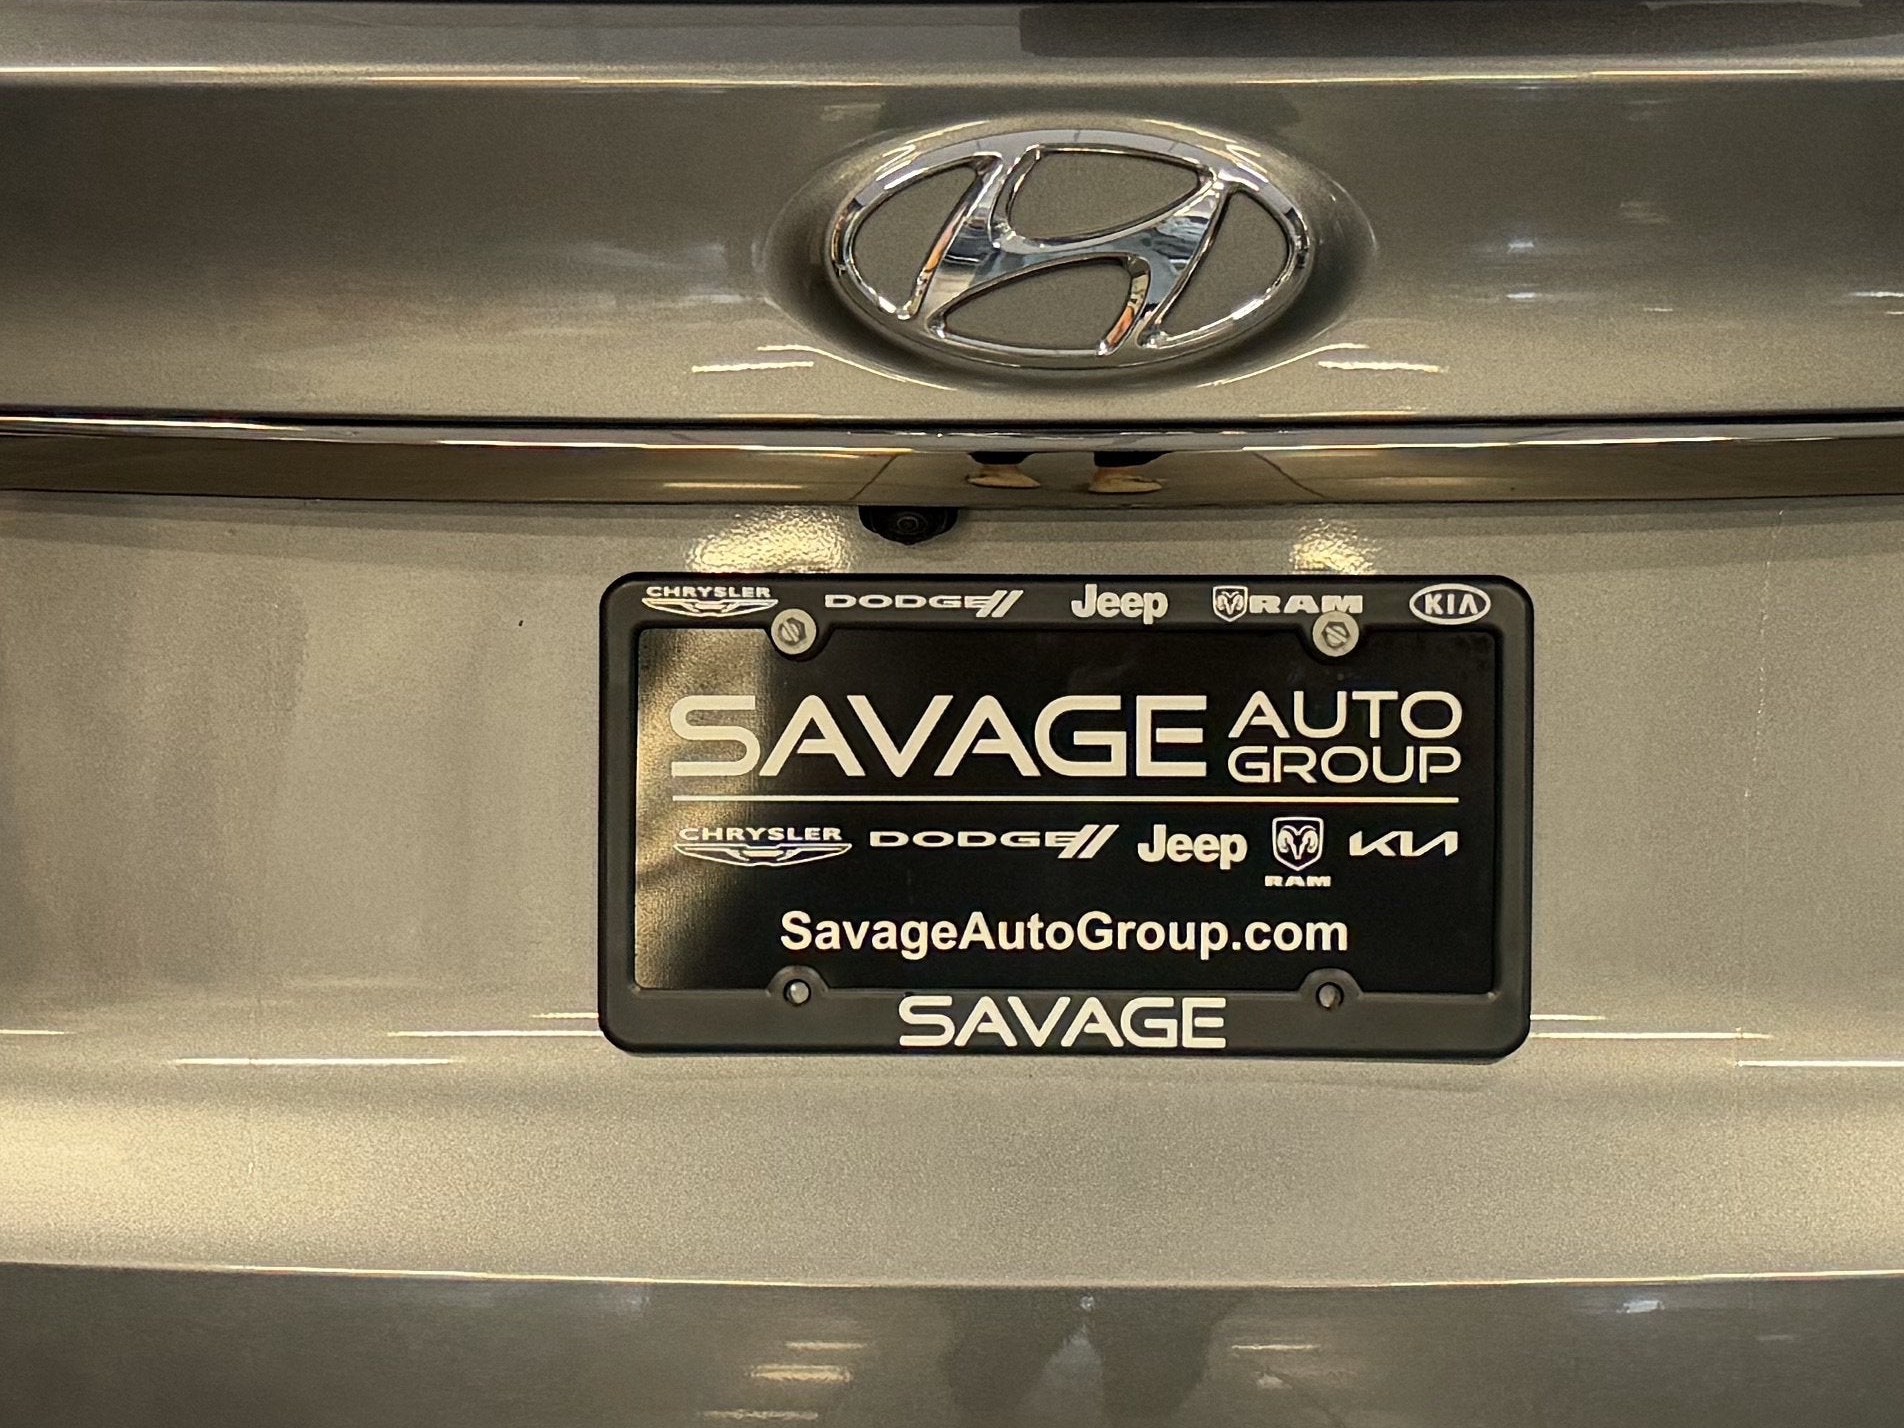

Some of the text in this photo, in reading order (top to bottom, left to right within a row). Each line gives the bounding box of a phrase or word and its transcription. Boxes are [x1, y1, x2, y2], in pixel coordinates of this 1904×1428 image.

[646, 583, 1480, 624] CHRYSLER DODGE Jeep RAM KIA
[670, 690, 1464, 777] SAVAGE AUTO
[1227, 745, 1462, 784] GROUP
[678, 827, 843, 842] CHRYSLER
[869, 831, 1082, 848] DODGE
[1137, 824, 1248, 870] Jeep
[1264, 875, 1332, 888] RAM
[779, 910, 1349, 961] SavageAutoGroup.com
[898, 995, 1227, 1048] SAVAGE
